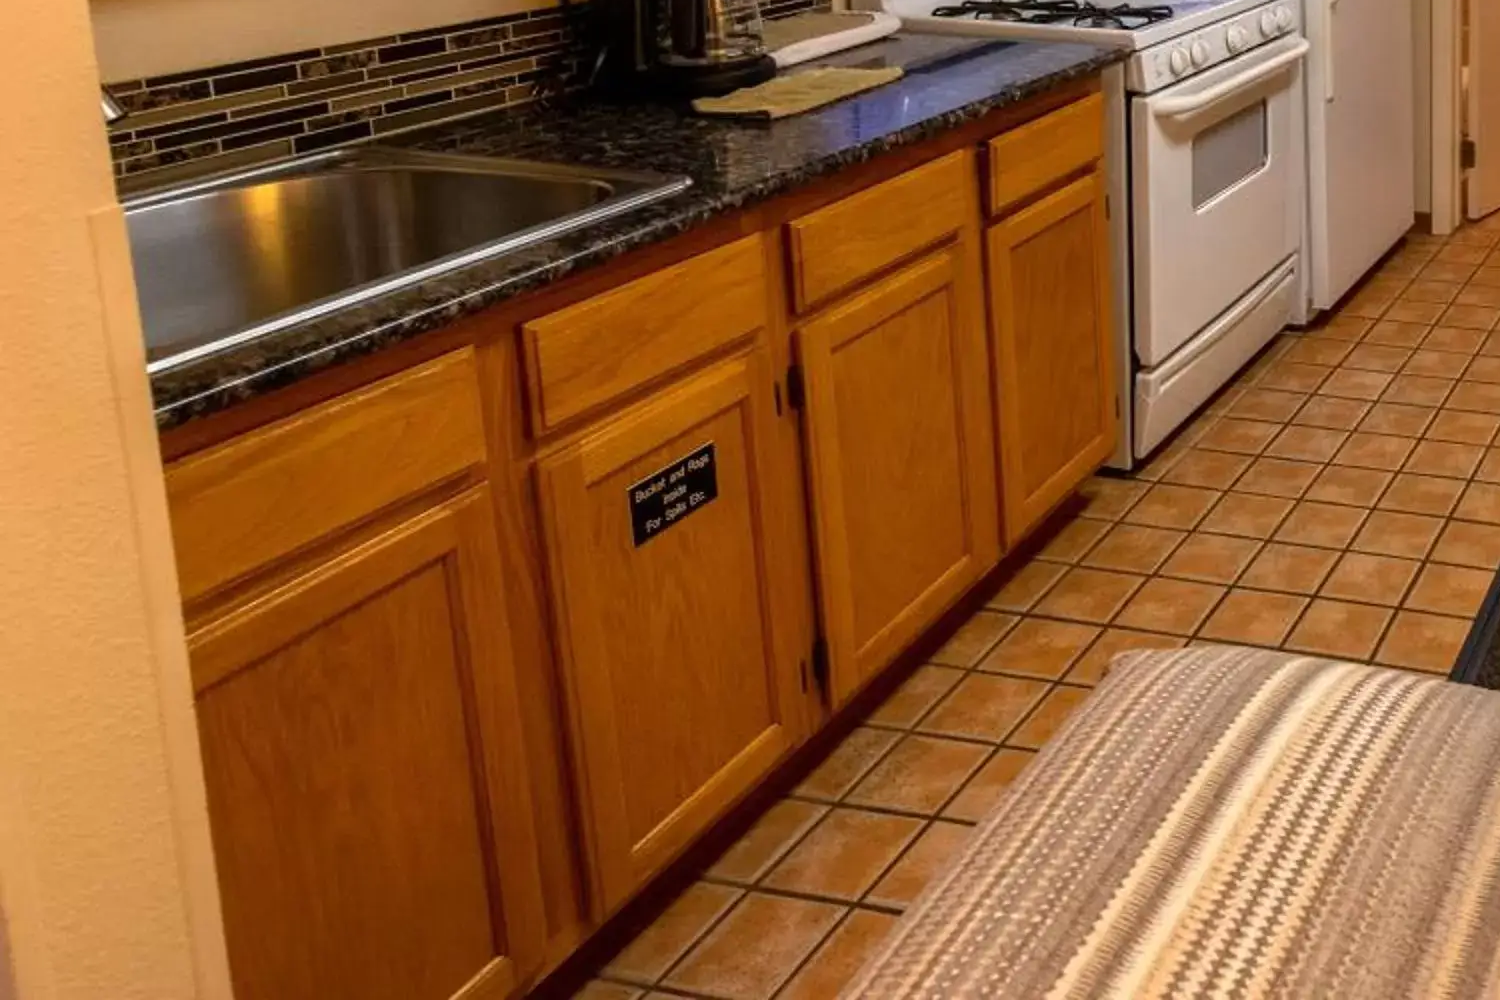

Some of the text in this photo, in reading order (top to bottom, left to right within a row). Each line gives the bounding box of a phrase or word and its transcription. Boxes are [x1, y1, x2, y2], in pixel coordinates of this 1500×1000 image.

[635, 477, 665, 503] Bucket
[670, 464, 685, 484] and
[645, 516, 661, 533] For
[665, 502, 687, 521] Spills
